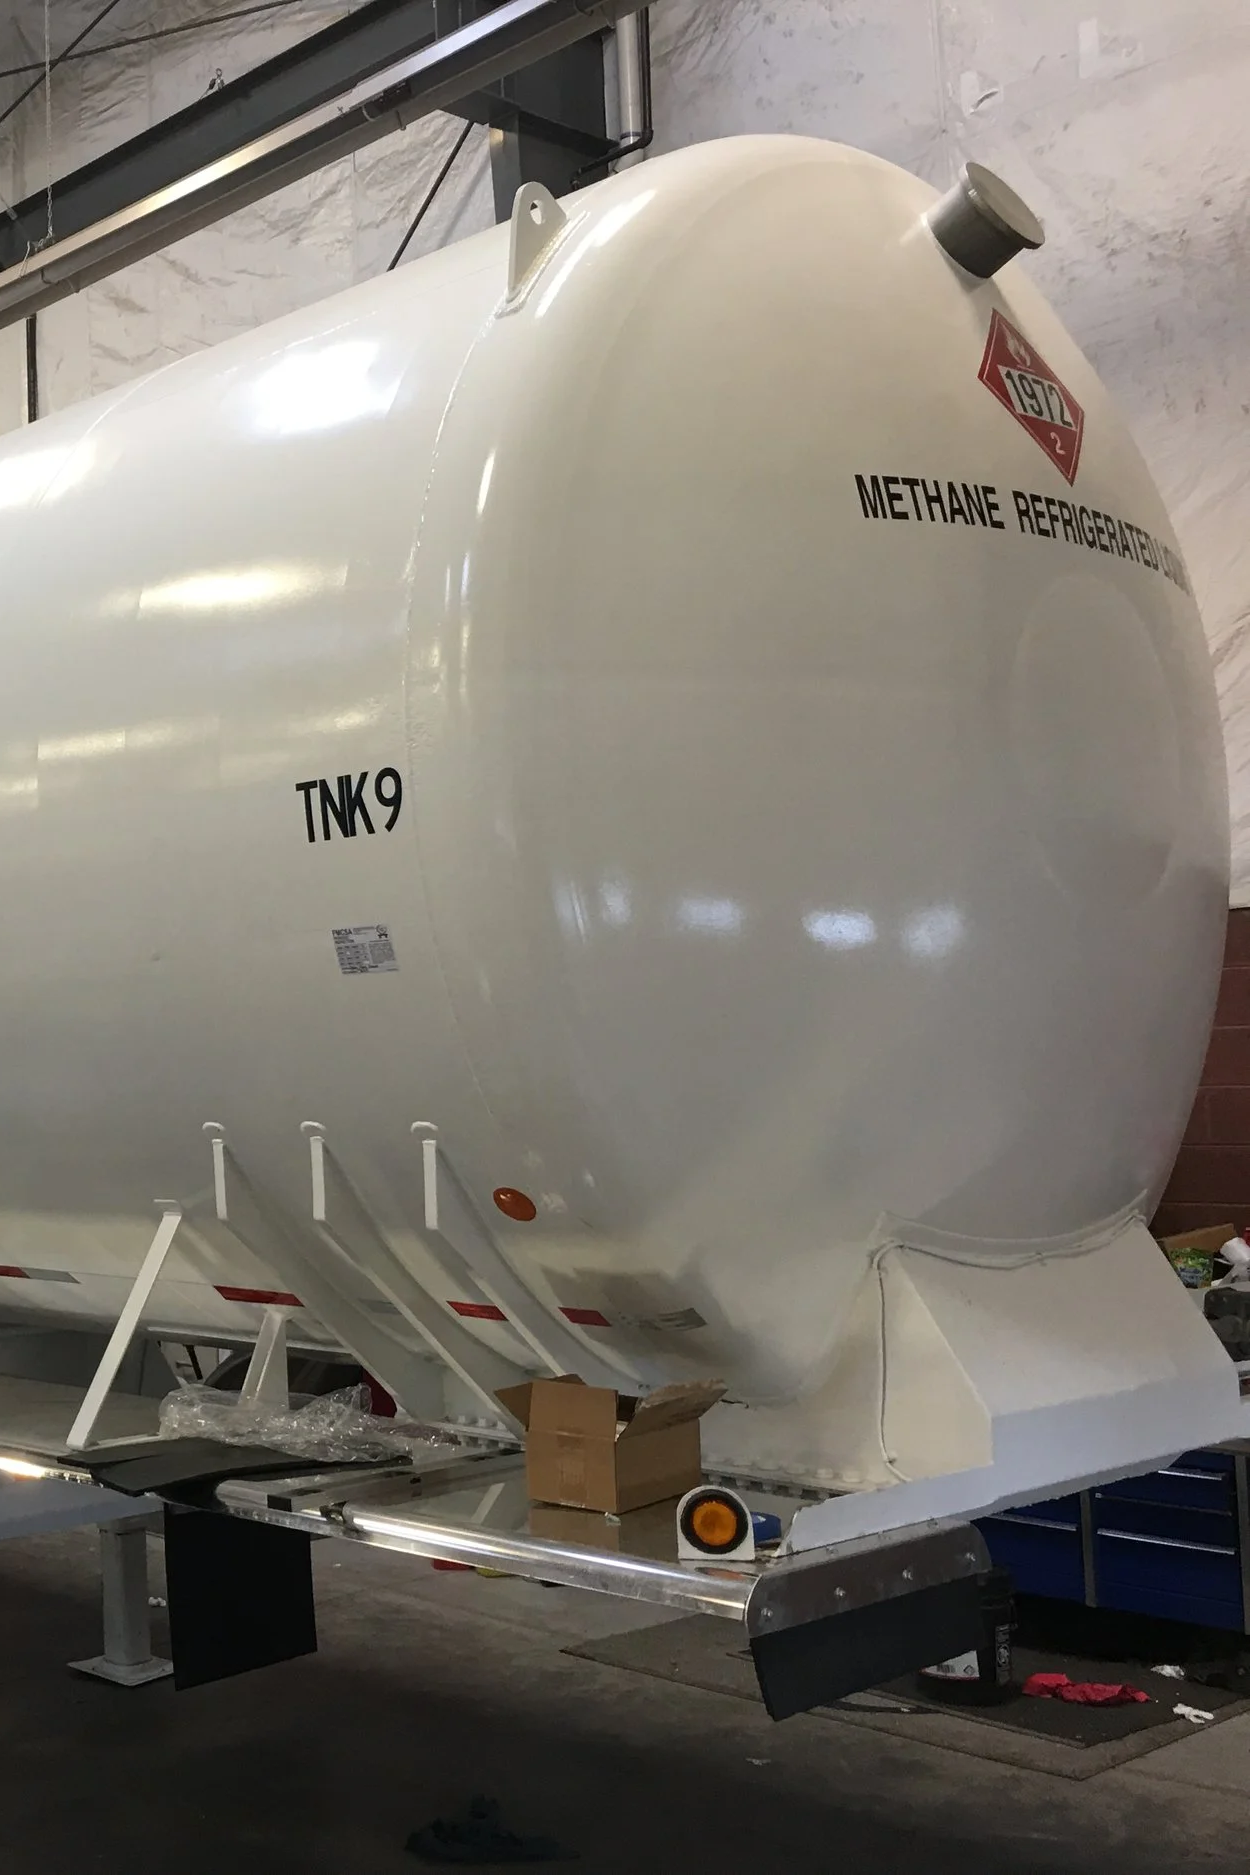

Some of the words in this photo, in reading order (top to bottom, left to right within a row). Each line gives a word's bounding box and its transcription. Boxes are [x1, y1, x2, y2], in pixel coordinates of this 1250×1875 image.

[1005, 369, 1074, 428] 1972
[1050, 432, 1066, 455] 2
[854, 474, 1005, 529] METHANE
[1012, 490, 1159, 571] REFRIGERATED
[295, 767, 402, 843] TNK9
